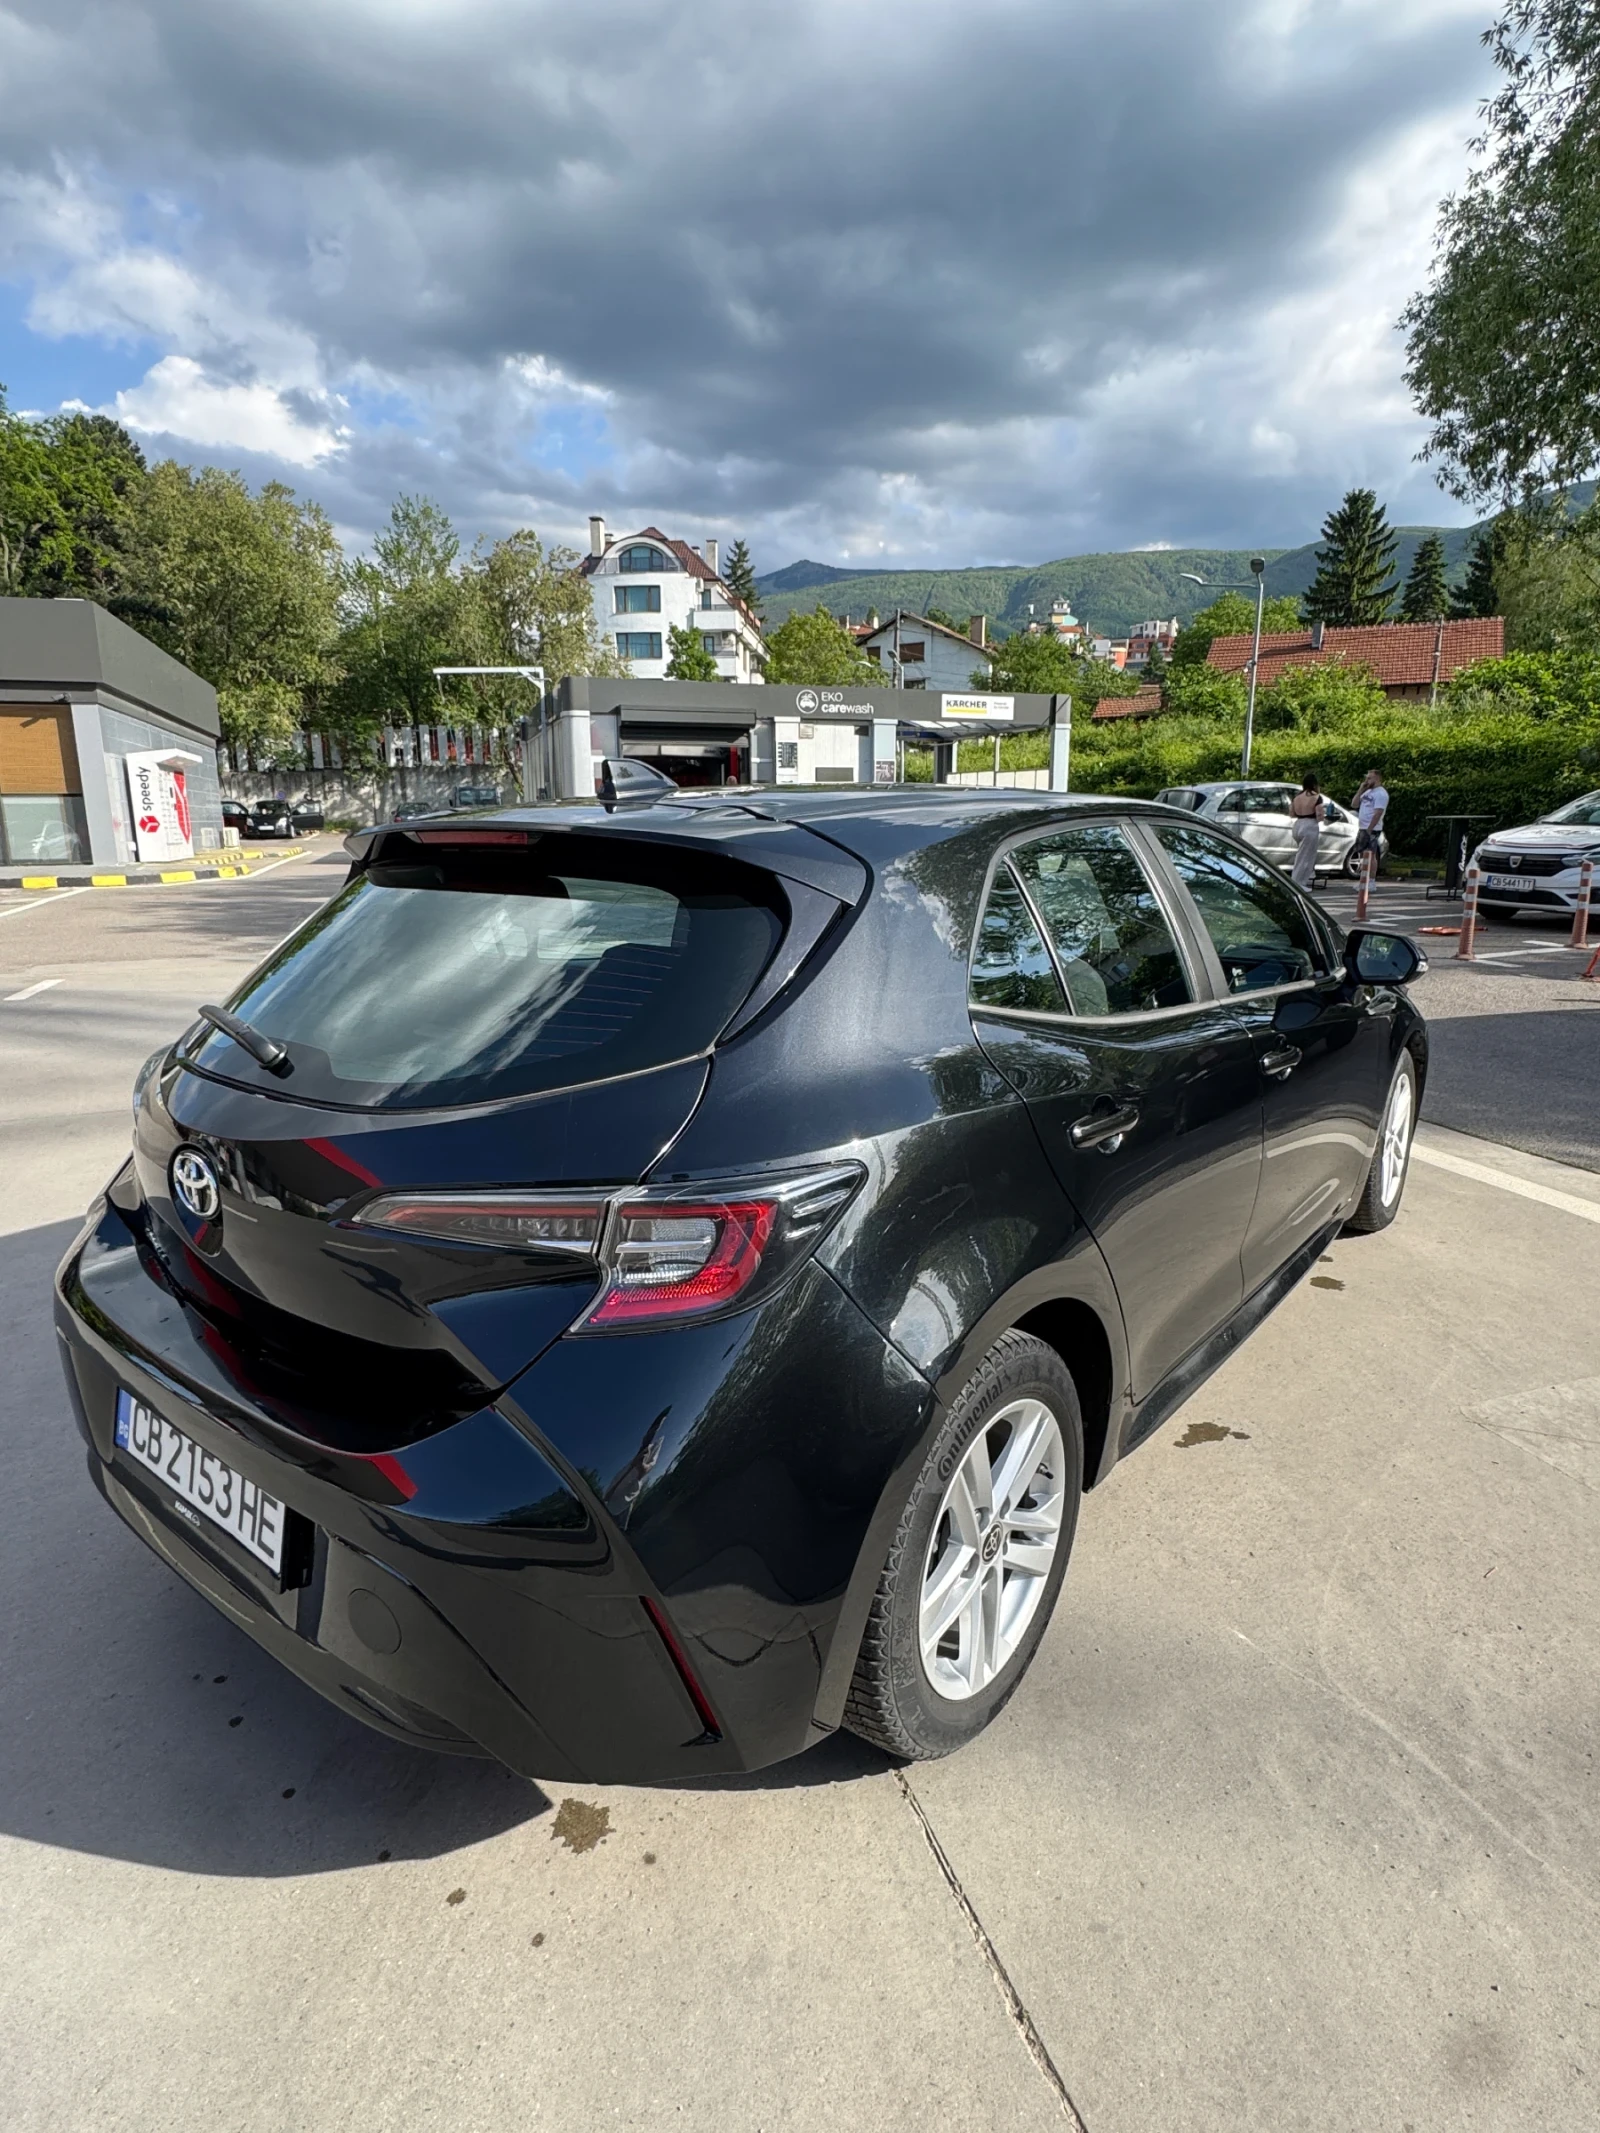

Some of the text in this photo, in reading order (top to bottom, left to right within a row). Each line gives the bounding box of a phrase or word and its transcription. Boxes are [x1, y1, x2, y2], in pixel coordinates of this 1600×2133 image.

[821, 692, 843, 702] EKO
[946, 699, 987, 709] KÄRCHER
[821, 703, 874, 715] carewash
[136, 766, 154, 811] speedy
[1492, 877, 1533, 889] CB 5441 TT
[119, 1420, 129, 1439] BG
[938, 1374, 1005, 1482] Continental
[132, 1402, 278, 1559] CB 2153 HE
